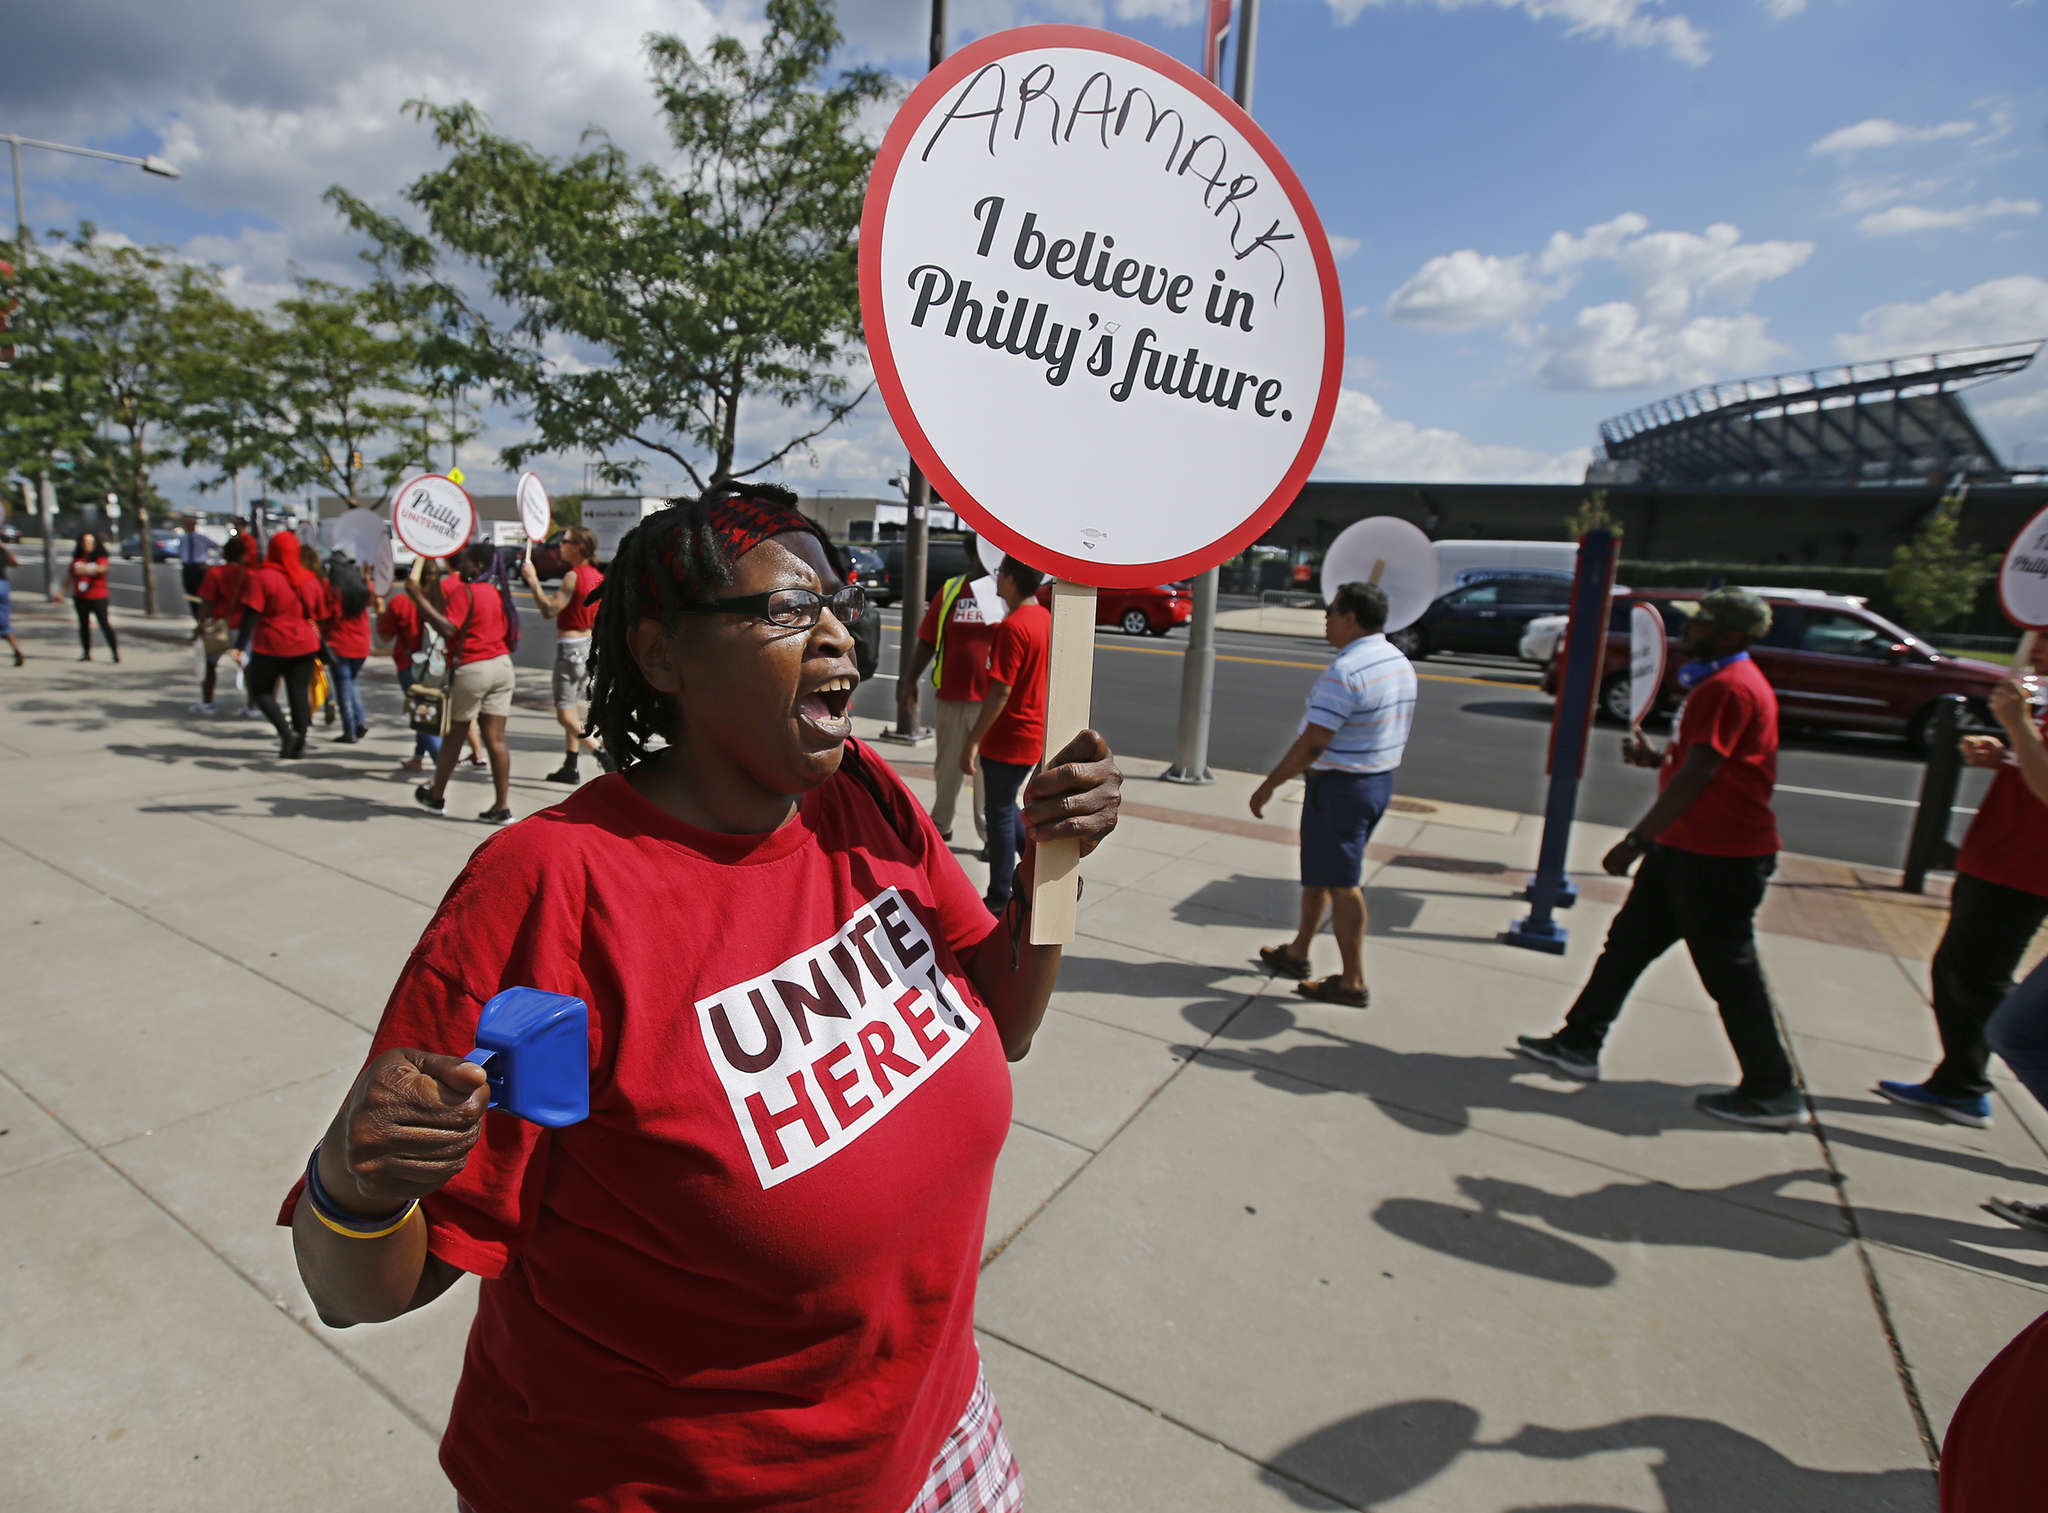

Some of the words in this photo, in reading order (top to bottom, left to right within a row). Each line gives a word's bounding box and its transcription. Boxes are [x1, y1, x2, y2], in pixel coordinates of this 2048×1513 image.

[921, 62, 1295, 309] ARAMARK
[973, 195, 1006, 257] I
[1013, 211, 1193, 314] believe
[1205, 268, 1254, 332] in
[907, 264, 1113, 387] Philly's
[1109, 327, 1294, 422] future.
[412, 487, 461, 530] Philly
[955, 610, 983, 620] HER
[708, 896, 931, 1074] UNITE
